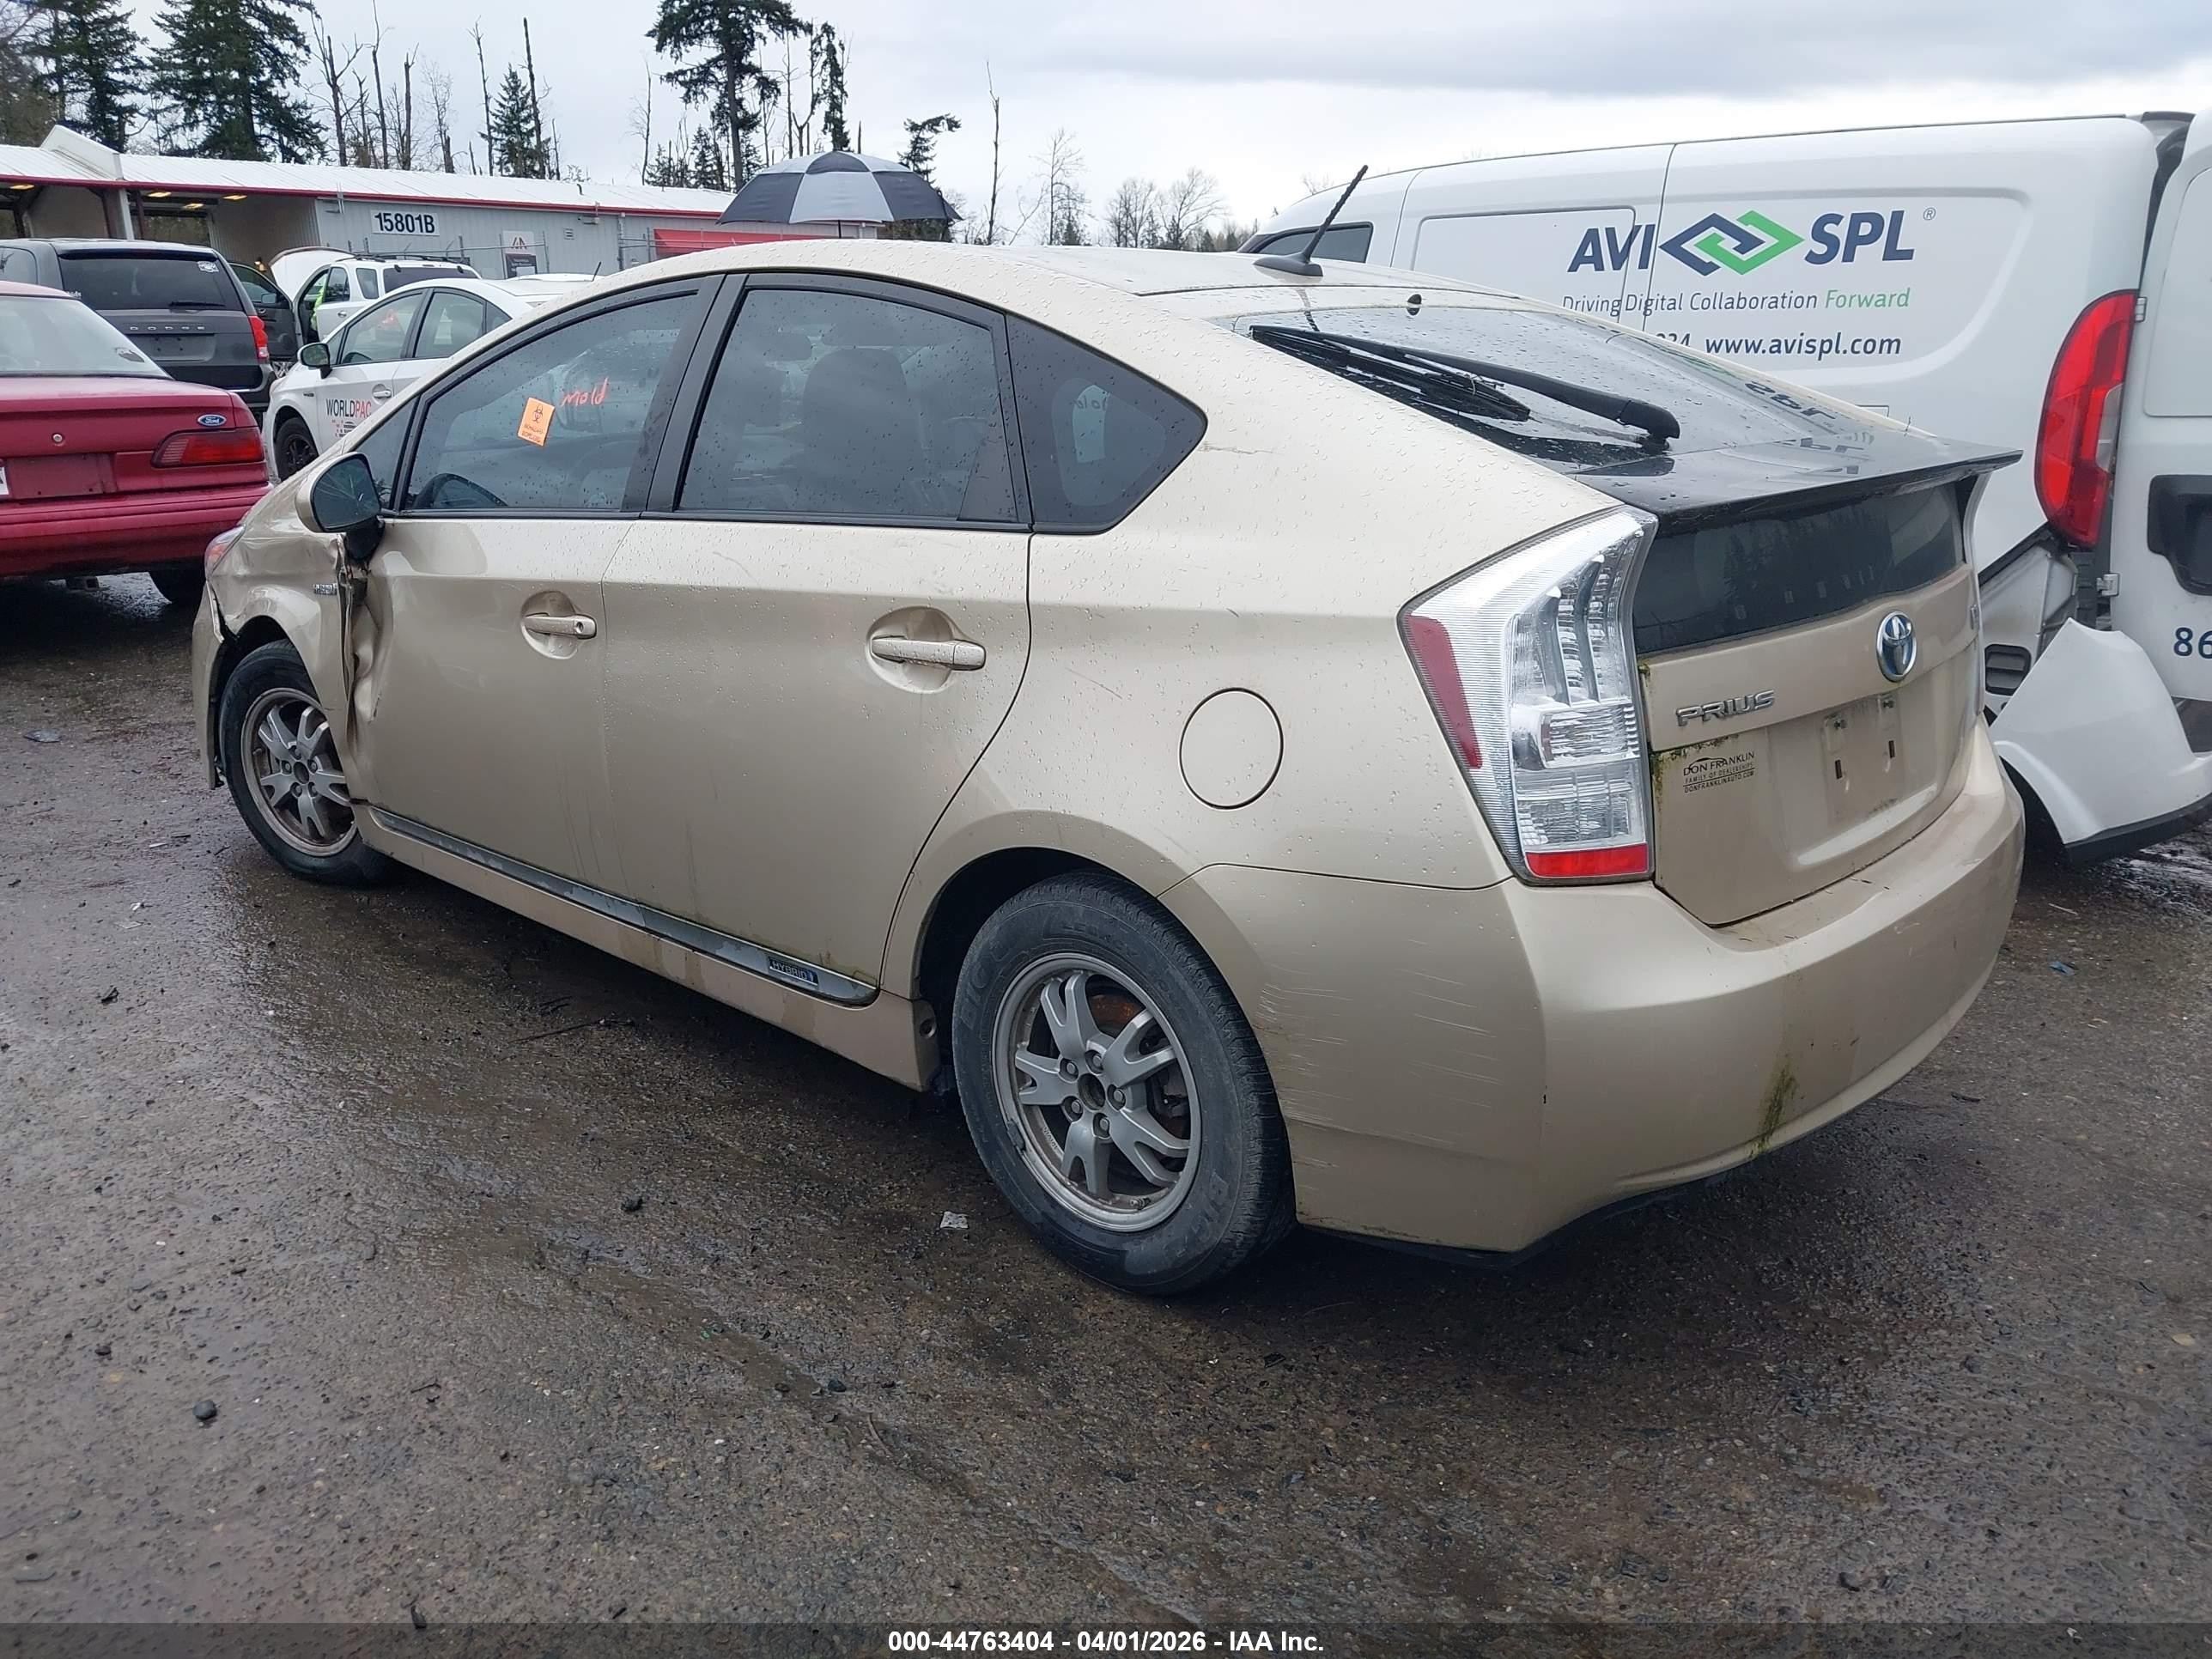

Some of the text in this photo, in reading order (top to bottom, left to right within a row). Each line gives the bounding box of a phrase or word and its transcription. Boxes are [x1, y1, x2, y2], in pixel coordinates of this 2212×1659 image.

[374, 212, 434, 233] 15801B
[1567, 224, 1656, 272] AVI
[1804, 210, 1915, 264] SPL
[1563, 288, 1911, 317] Driving Digital Collaboration Forward
[1705, 331, 1901, 362] www.avispl.com
[326, 398, 372, 418] WORLDPAC
[2173, 627, 2212, 659] 86
[1675, 690, 1774, 726] PRIUS
[1683, 751, 1755, 776] DON FRANKLIN
[772, 960, 808, 980] HYBRID
